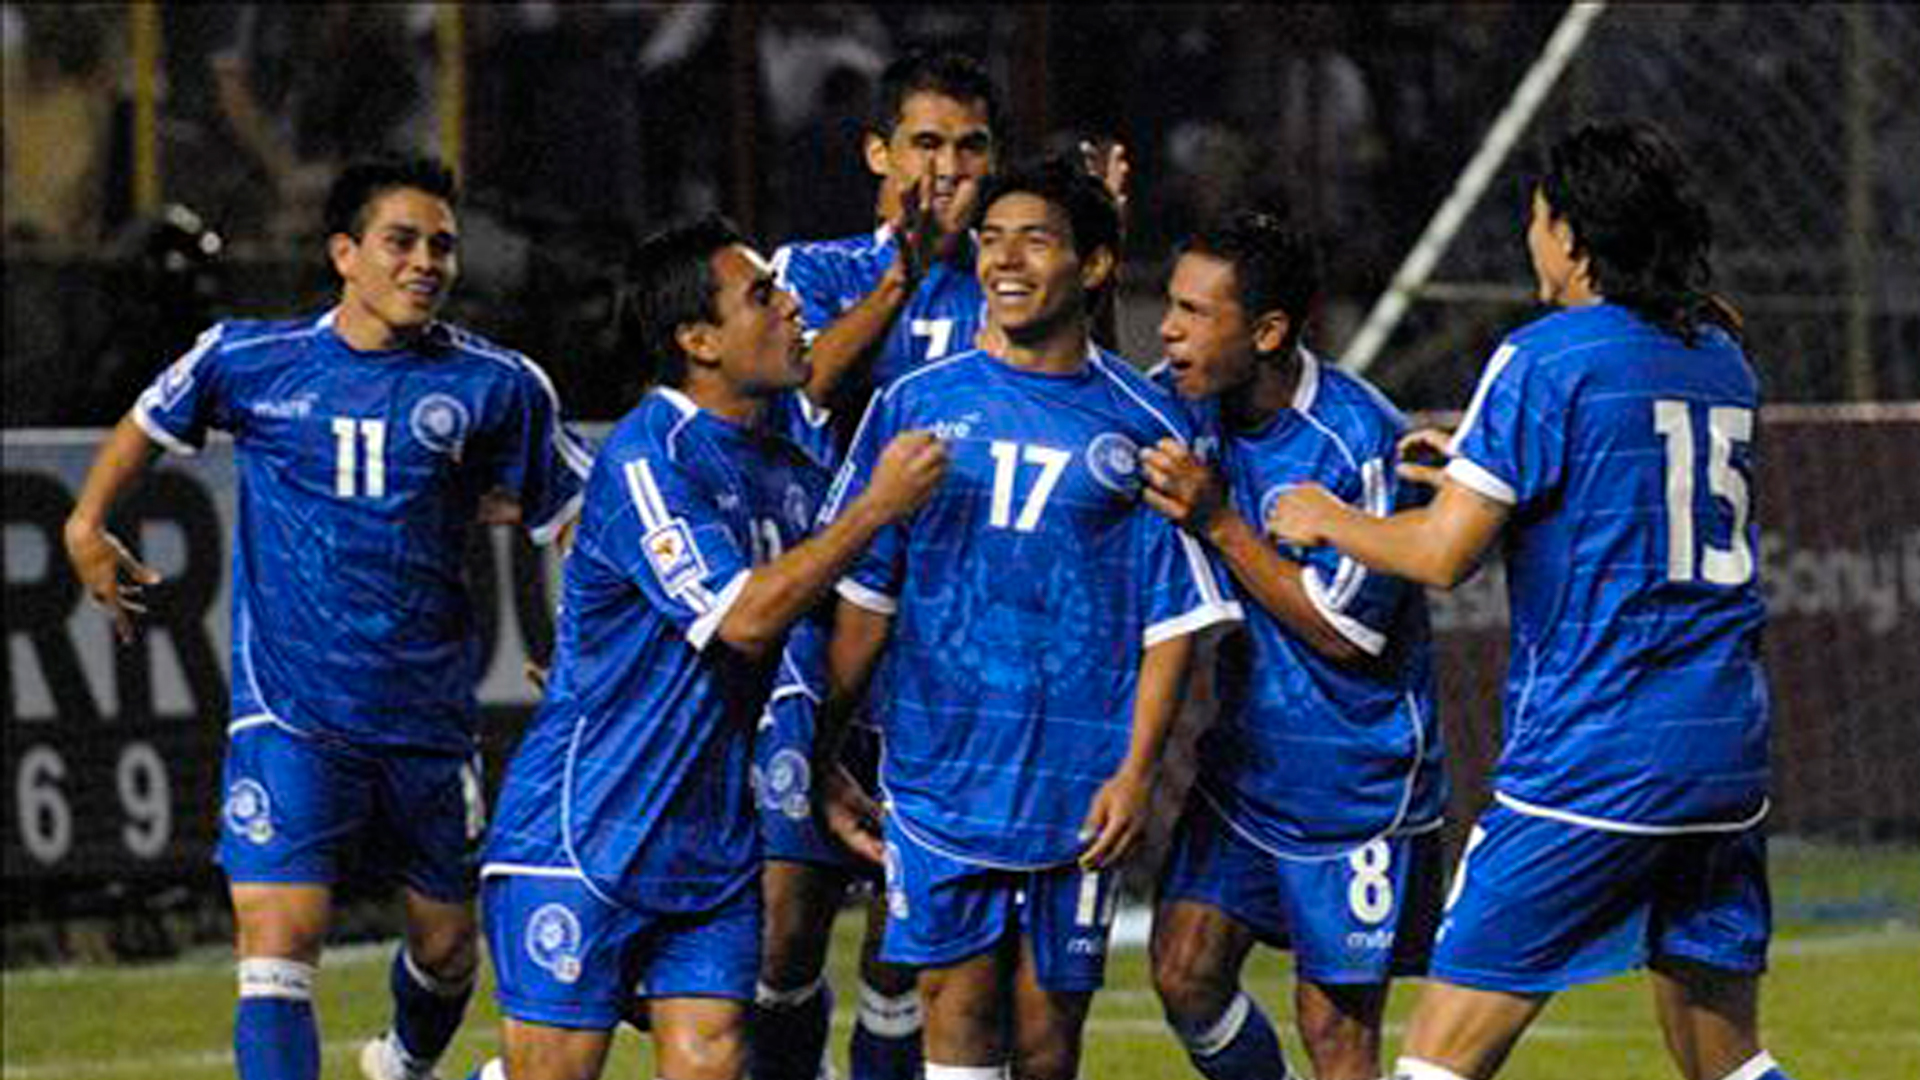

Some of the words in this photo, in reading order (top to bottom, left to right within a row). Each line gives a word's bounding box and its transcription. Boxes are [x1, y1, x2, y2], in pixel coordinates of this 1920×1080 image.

[332, 417, 387, 498] 11
[989, 440, 1073, 531] 17
[1654, 400, 1753, 584] 15
[1347, 838, 1394, 925] 8
